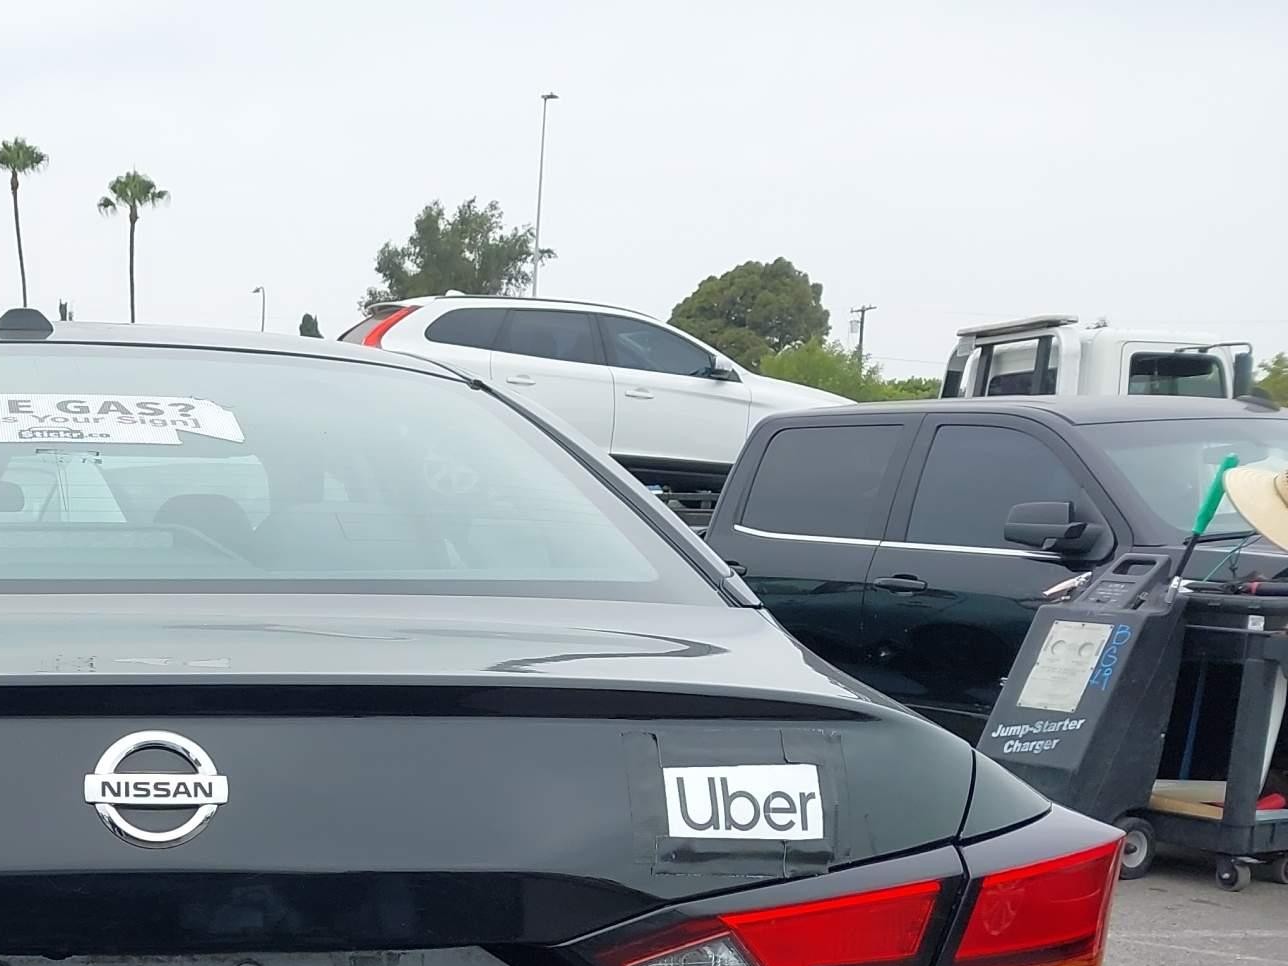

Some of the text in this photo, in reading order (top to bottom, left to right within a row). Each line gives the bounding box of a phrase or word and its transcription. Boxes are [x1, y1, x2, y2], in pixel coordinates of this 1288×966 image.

[56, 400, 196, 418] GAS?
[31, 414, 105, 424] Your
[117, 415, 202, 429] Sign]
[991, 718, 1087, 738] Jump-Starter
[1003, 739, 1061, 754] Charger
[101, 781, 213, 798] NISSAN
[676, 776, 816, 832] Uber
